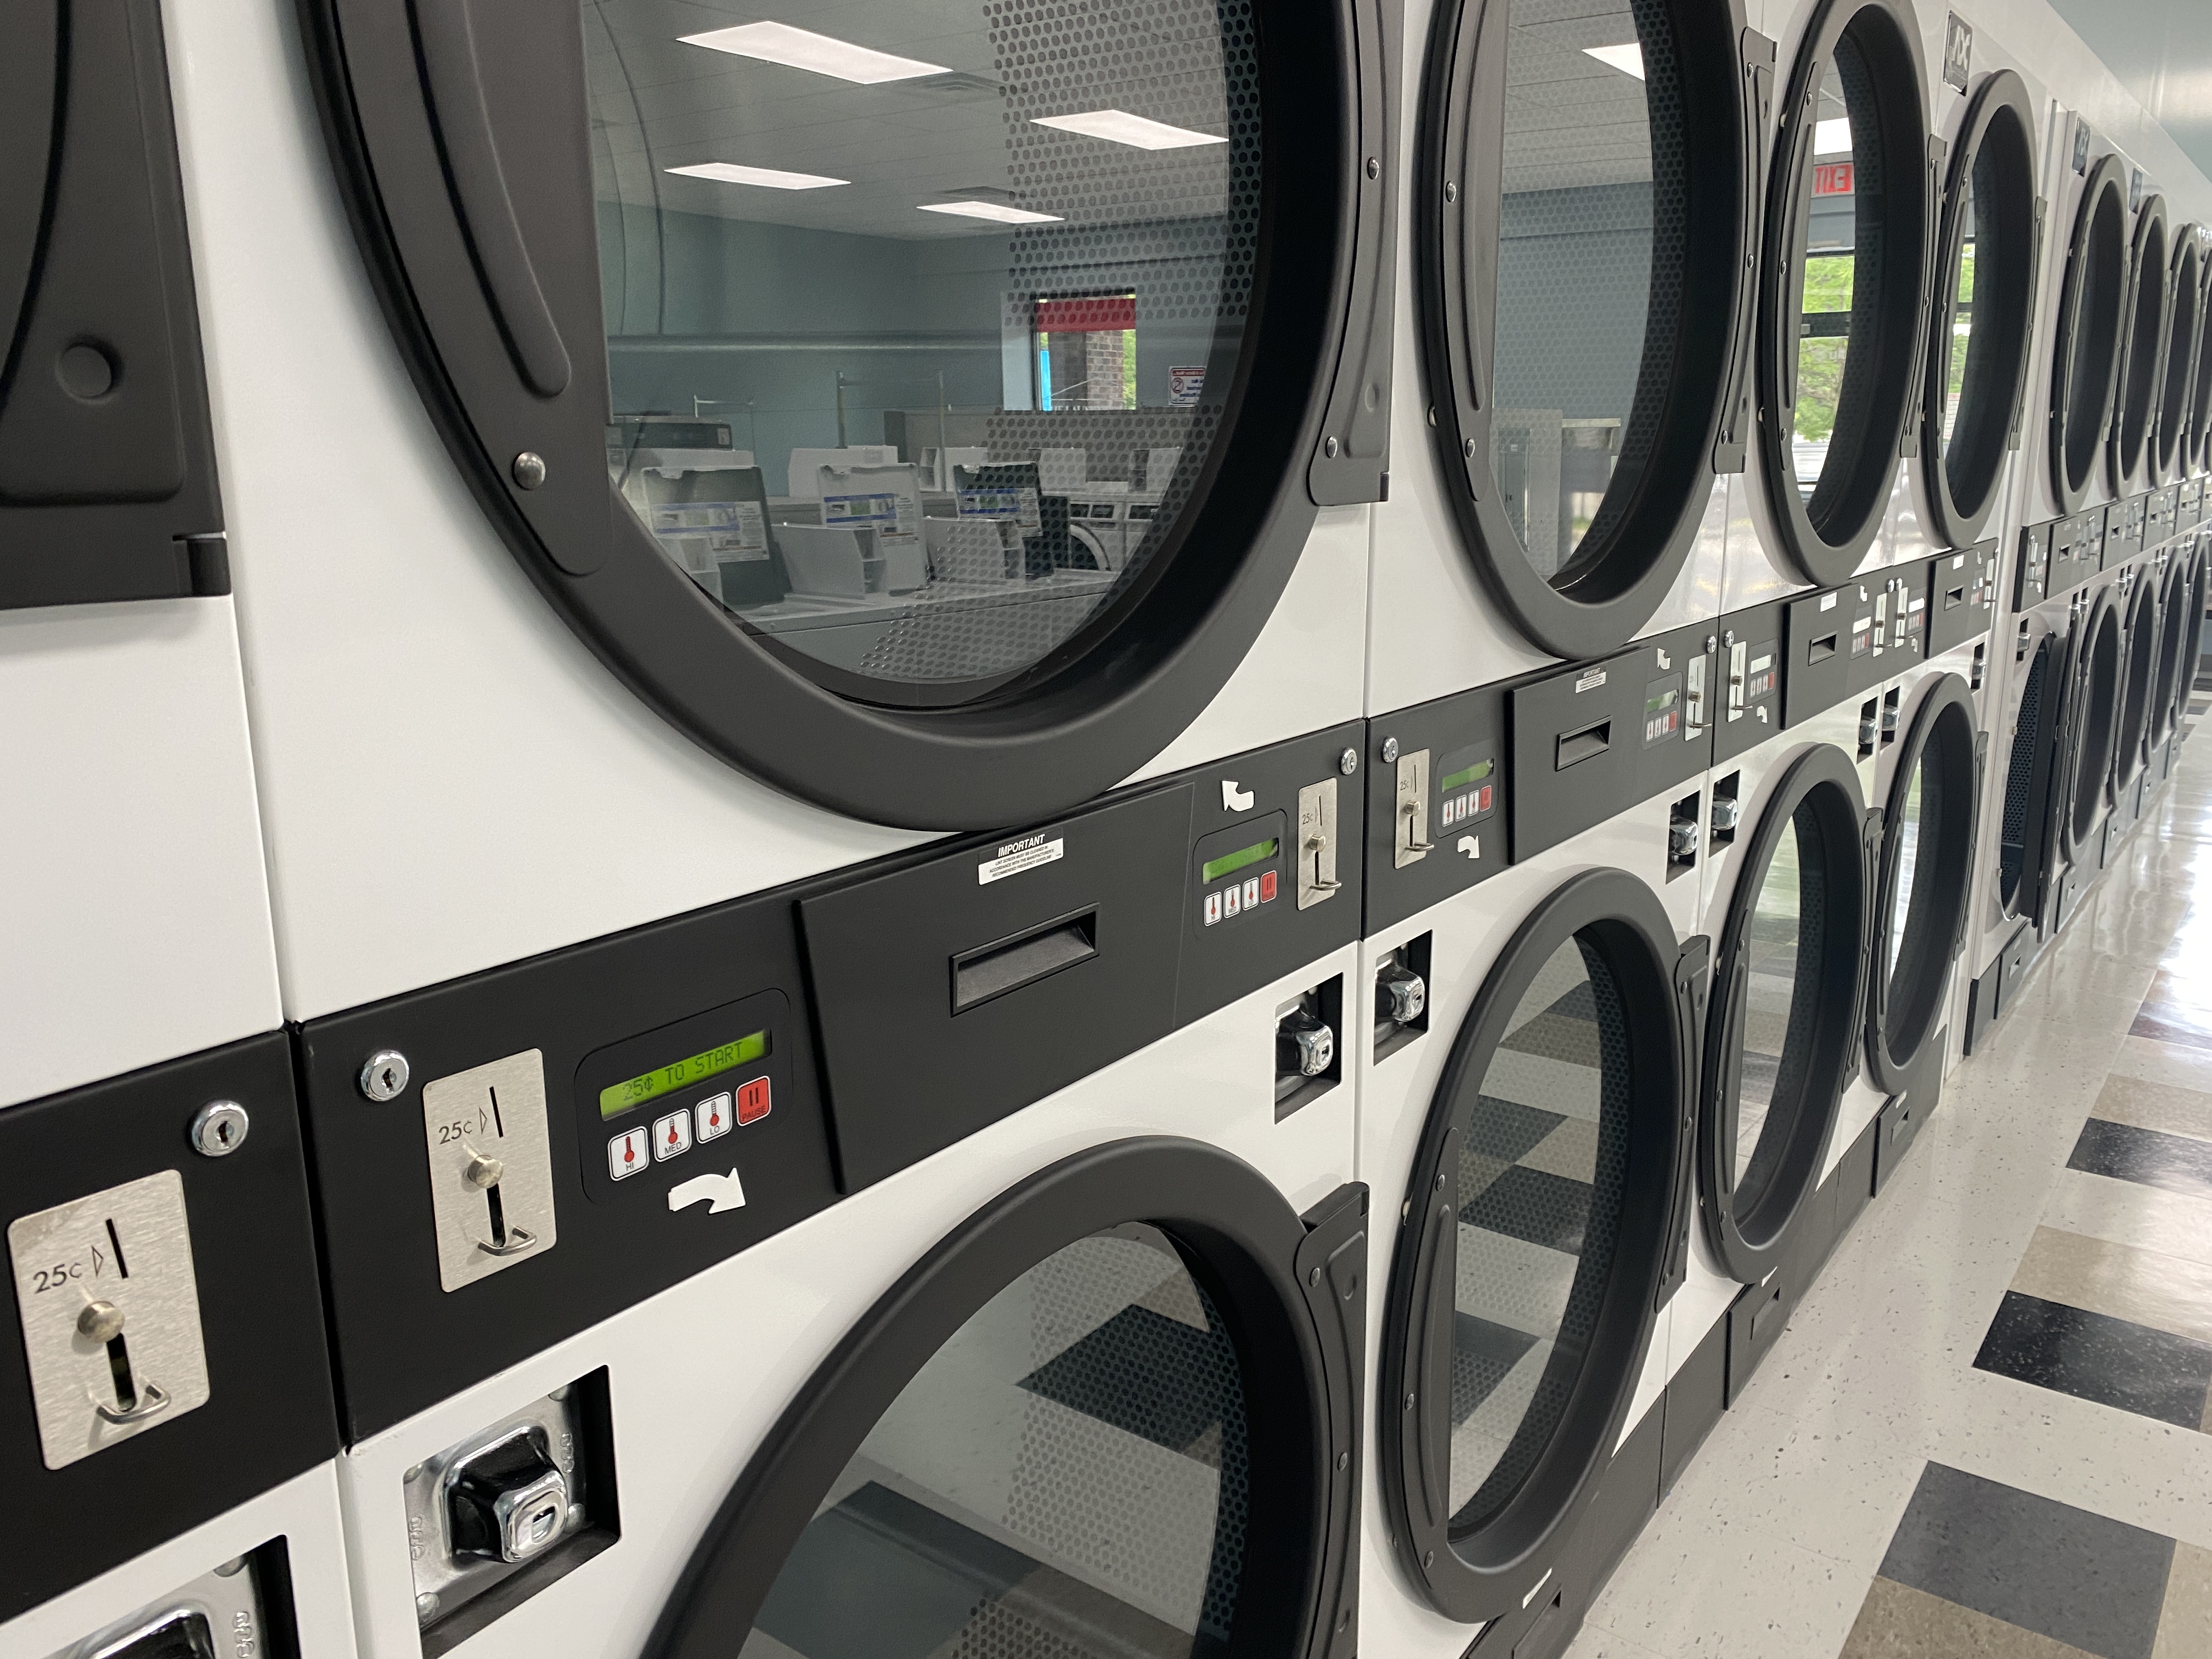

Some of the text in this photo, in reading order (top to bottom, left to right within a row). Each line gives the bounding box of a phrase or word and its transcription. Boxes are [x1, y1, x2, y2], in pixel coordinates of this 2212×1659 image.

[997, 834, 1046, 857] IMPORTANT
[665, 1063, 685, 1085] TO
[695, 1041, 743, 1074] START
[742, 1105, 766, 1121] PAUSE
[709, 1125, 720, 1135] LO
[664, 1142, 682, 1155] MED
[625, 1162, 634, 1171] HI
